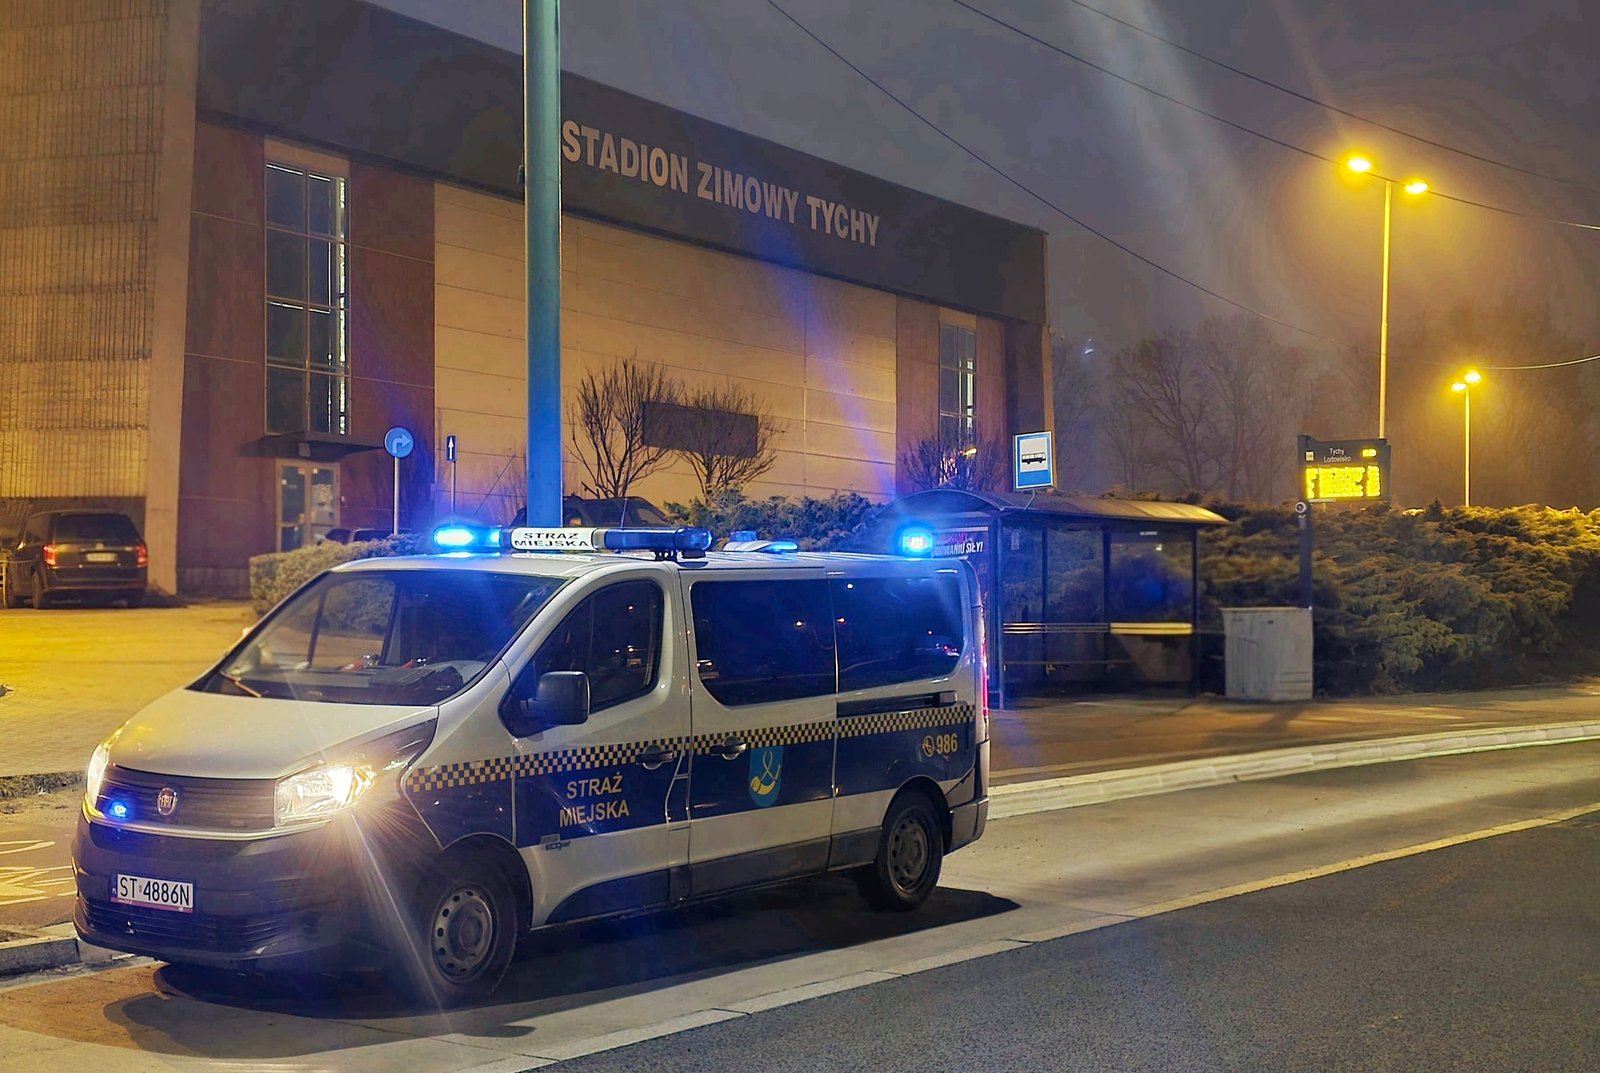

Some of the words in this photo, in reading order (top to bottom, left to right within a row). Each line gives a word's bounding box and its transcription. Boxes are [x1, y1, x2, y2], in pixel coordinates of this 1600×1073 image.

[562, 120, 688, 194] STADION
[697, 161, 799, 224] ZIMOWY
[807, 195, 880, 247] TYCHY
[1329, 447, 1345, 456] Tychy
[936, 733, 958, 754] 986
[566, 771, 623, 799] STRAŻ
[559, 799, 630, 828] MIEJSKA
[120, 877, 138, 898] ST
[142, 880, 190, 906] 4886N
